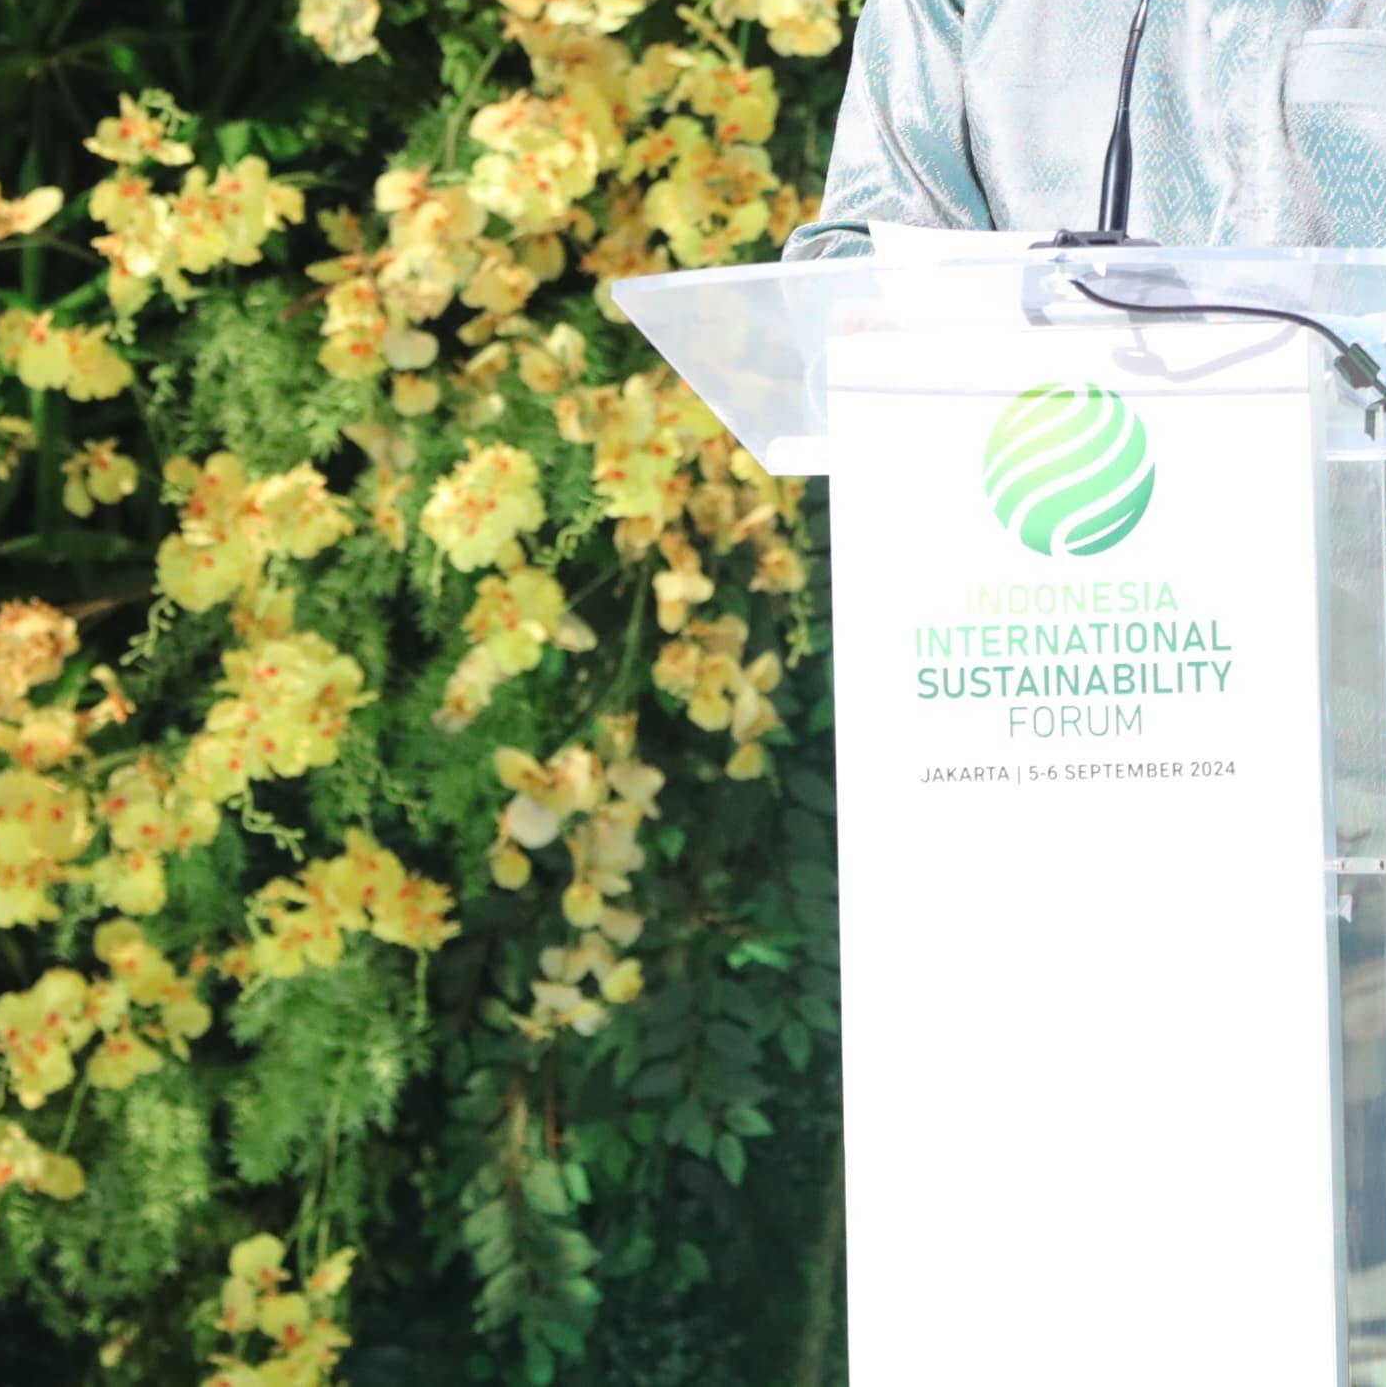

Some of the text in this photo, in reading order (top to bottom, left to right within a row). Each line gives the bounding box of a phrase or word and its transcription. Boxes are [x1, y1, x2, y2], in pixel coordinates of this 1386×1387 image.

[965, 582, 1179, 615] INDONESIA
[915, 620, 1233, 659] INTERNATIONAL
[917, 660, 1233, 700] SUSTAINABILITY
[1009, 704, 1143, 739] FORUM
[920, 766, 1010, 784] JAKARTA
[1029, 764, 1059, 782] 5-6
[1064, 762, 1184, 781] SEPTEMBER
[1190, 761, 1237, 779] 2024
